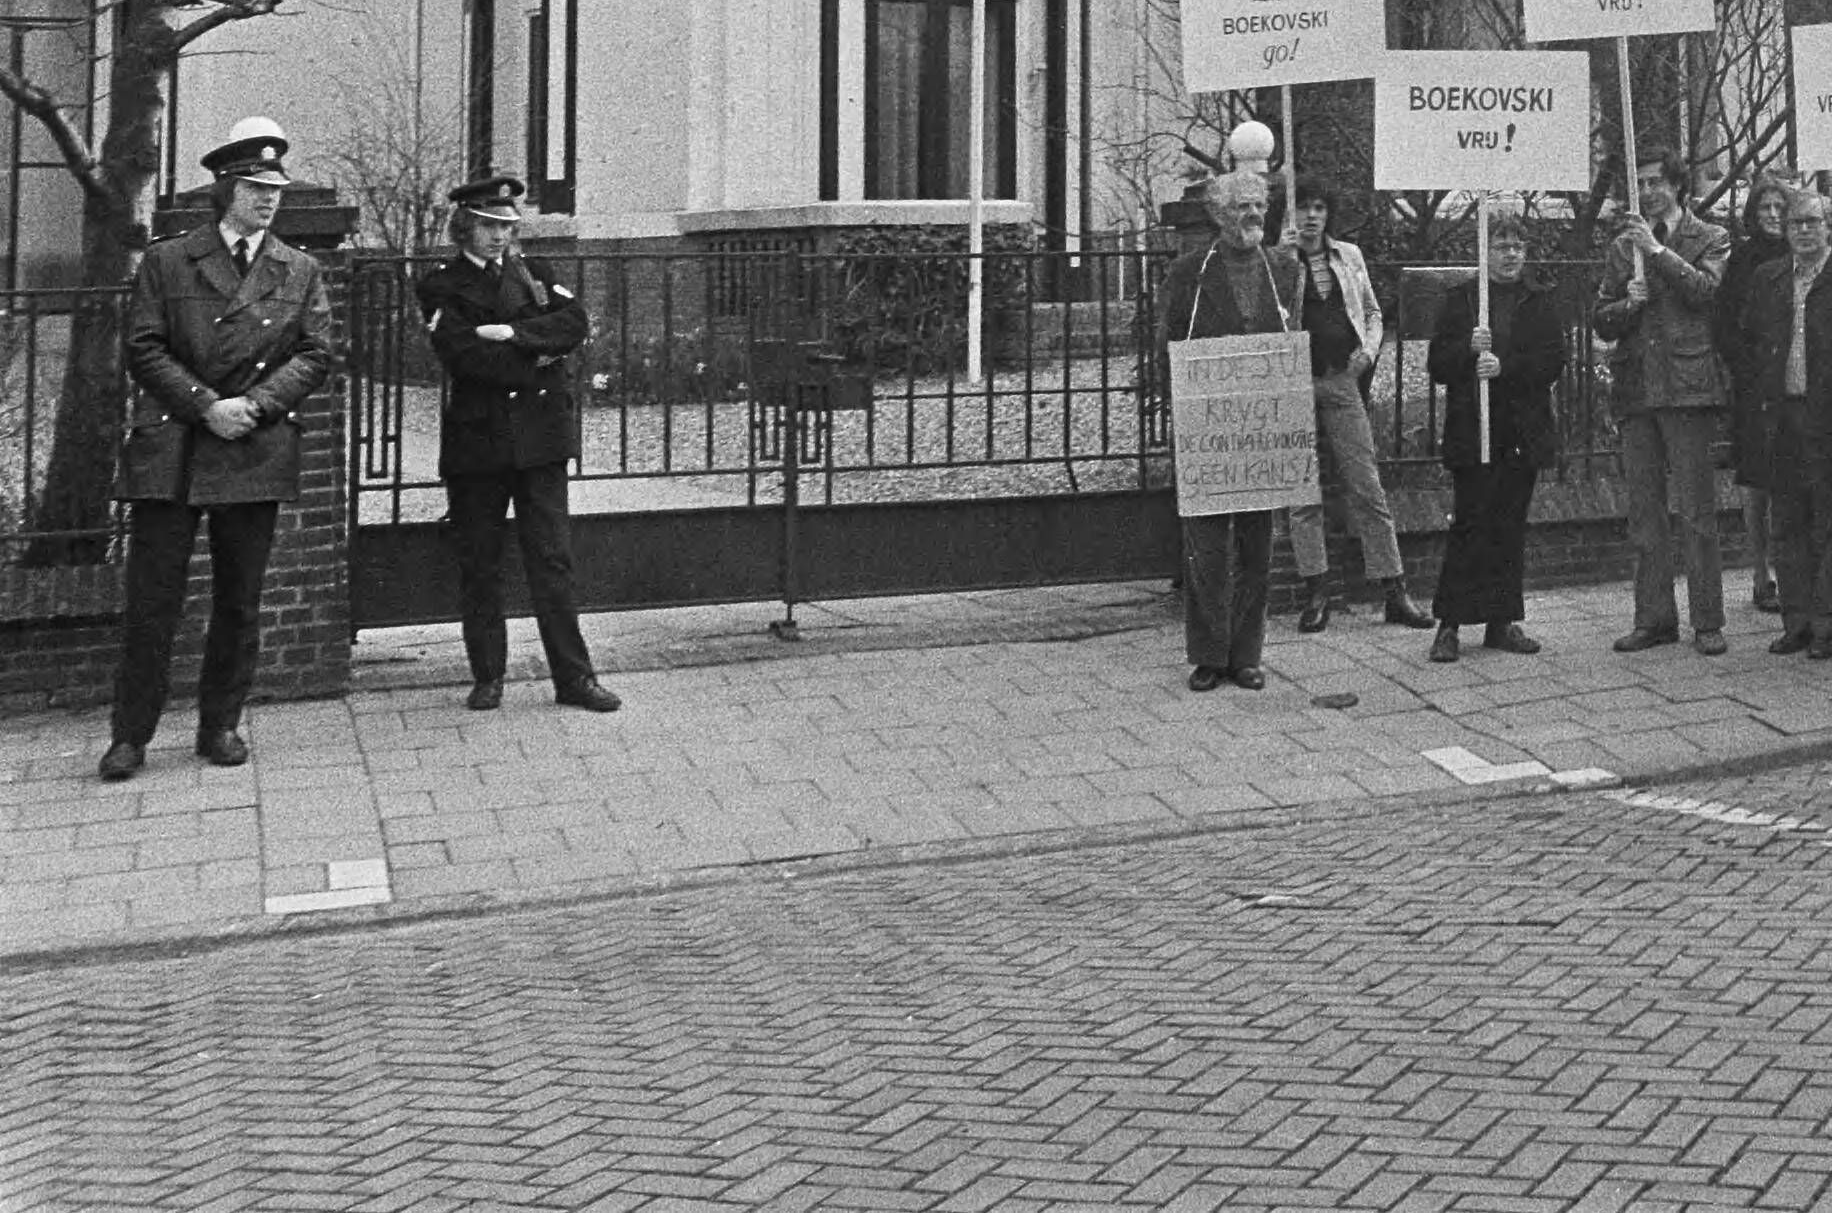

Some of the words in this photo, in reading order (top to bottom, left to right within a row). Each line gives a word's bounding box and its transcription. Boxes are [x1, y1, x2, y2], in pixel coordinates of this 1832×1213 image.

[1222, 9, 1329, 36] BOEKOVSKI
[1262, 37, 1300, 70] go!
[1408, 85, 1553, 113] BOEKOVSKI
